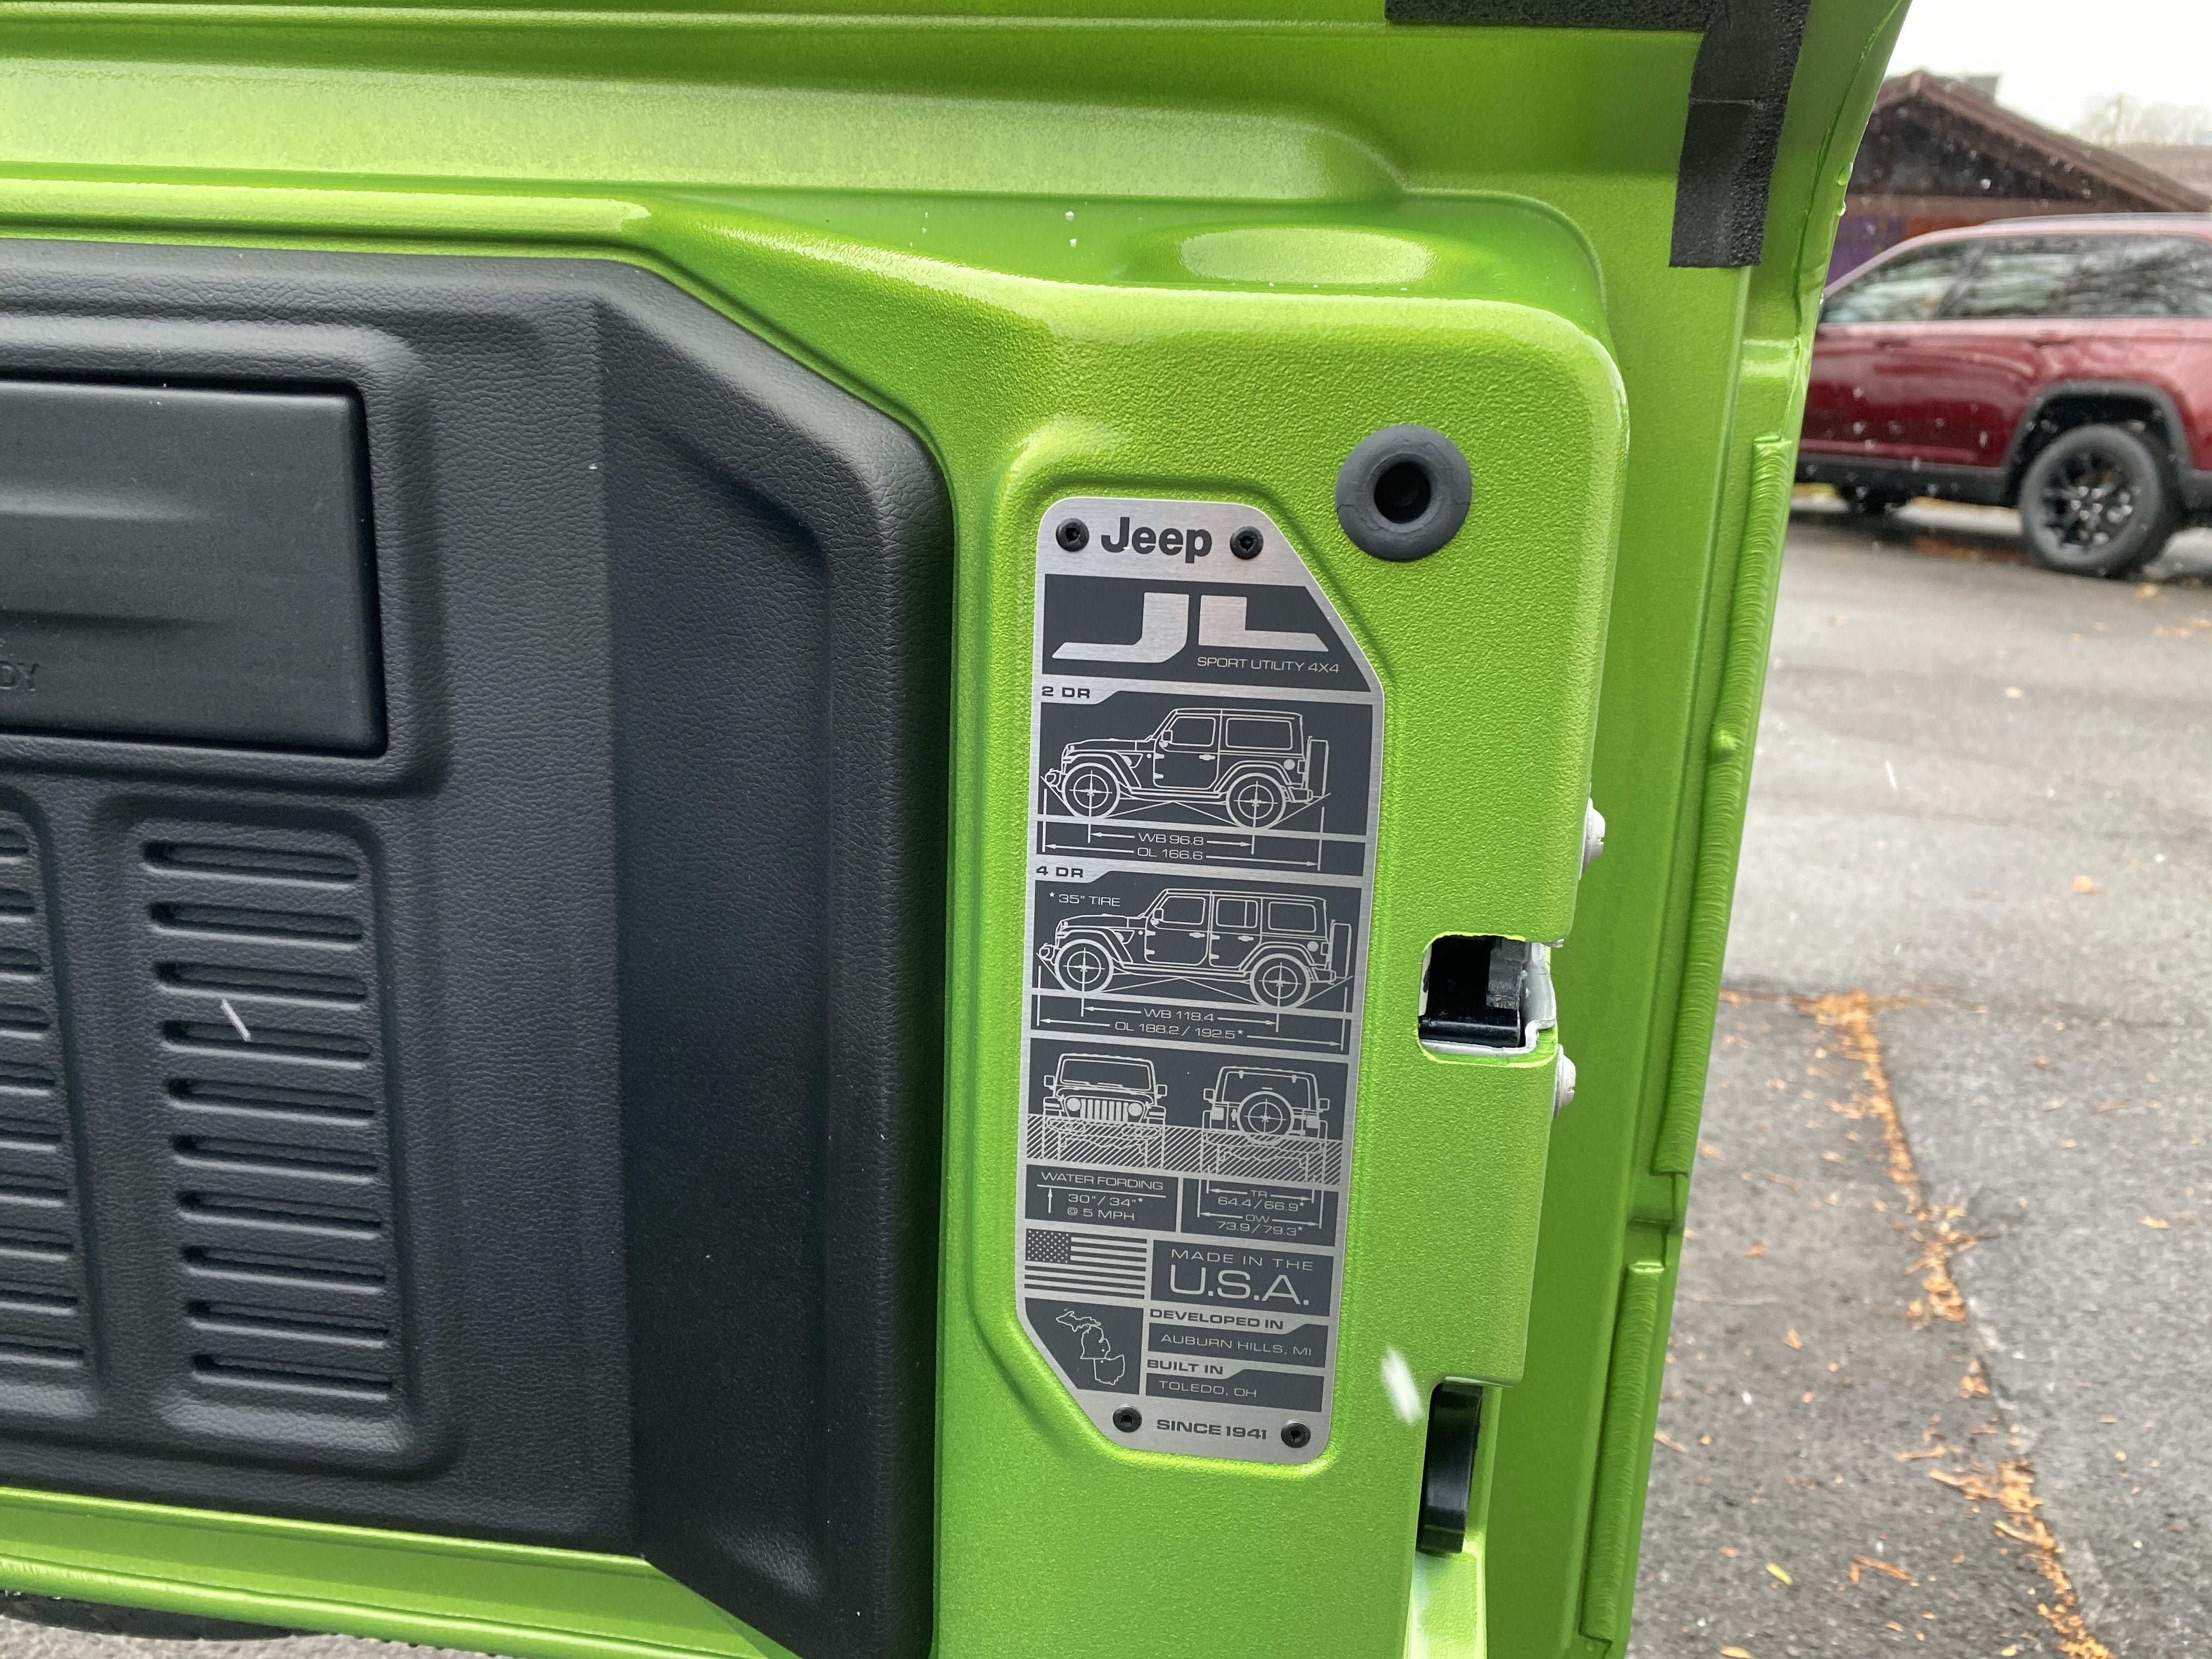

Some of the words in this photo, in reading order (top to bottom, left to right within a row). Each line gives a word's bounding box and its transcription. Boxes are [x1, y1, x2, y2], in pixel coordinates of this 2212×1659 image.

[1101, 516, 1212, 564] Jeep
[1052, 592, 1329, 664] JL
[1197, 656, 1248, 668] SPORT
[1251, 659, 1305, 672] UTILITY
[1308, 662, 1339, 673] 4X4
[1041, 686, 1054, 697] 2
[1062, 687, 1090, 699] DR
[1138, 832, 1166, 843] WB
[1169, 834, 1204, 846] 96.8
[1137, 847, 1157, 857] OL
[1161, 849, 1203, 860] 166.6
[1036, 866, 1048, 876] 4
[1056, 866, 1084, 878] DR
[1088, 895, 1121, 907] TIRE
[1143, 1008, 1171, 1019] WB
[1176, 1011, 1215, 1022] 118.4
[1115, 1021, 1135, 1031] OL
[1041, 1171, 1094, 1184] WATER
[1097, 1176, 1164, 1190] FORDING
[1250, 1189, 1267, 1199] TR
[1067, 1207, 1078, 1216] @
[1083, 1208, 1093, 1217] 5
[1098, 1209, 1135, 1221] MPH
[1245, 1214, 1270, 1223] OW
[1171, 1249, 1234, 1263] MADE
[1243, 1255, 1262, 1266] IN
[1272, 1258, 1313, 1271] THE
[1170, 1263, 1310, 1305] U.S.A.
[1150, 1308, 1260, 1328] DEVELOPED
[1265, 1319, 1283, 1330] IN
[1160, 1334, 1232, 1349] AUBURN
[1238, 1341, 1286, 1355] HILLS,
[1293, 1346, 1311, 1356] MI
[1147, 1359, 1199, 1372] BUILT
[1204, 1364, 1223, 1375] IN
[1158, 1380, 1228, 1396] TOLEDO,
[1234, 1388, 1257, 1398] OH
